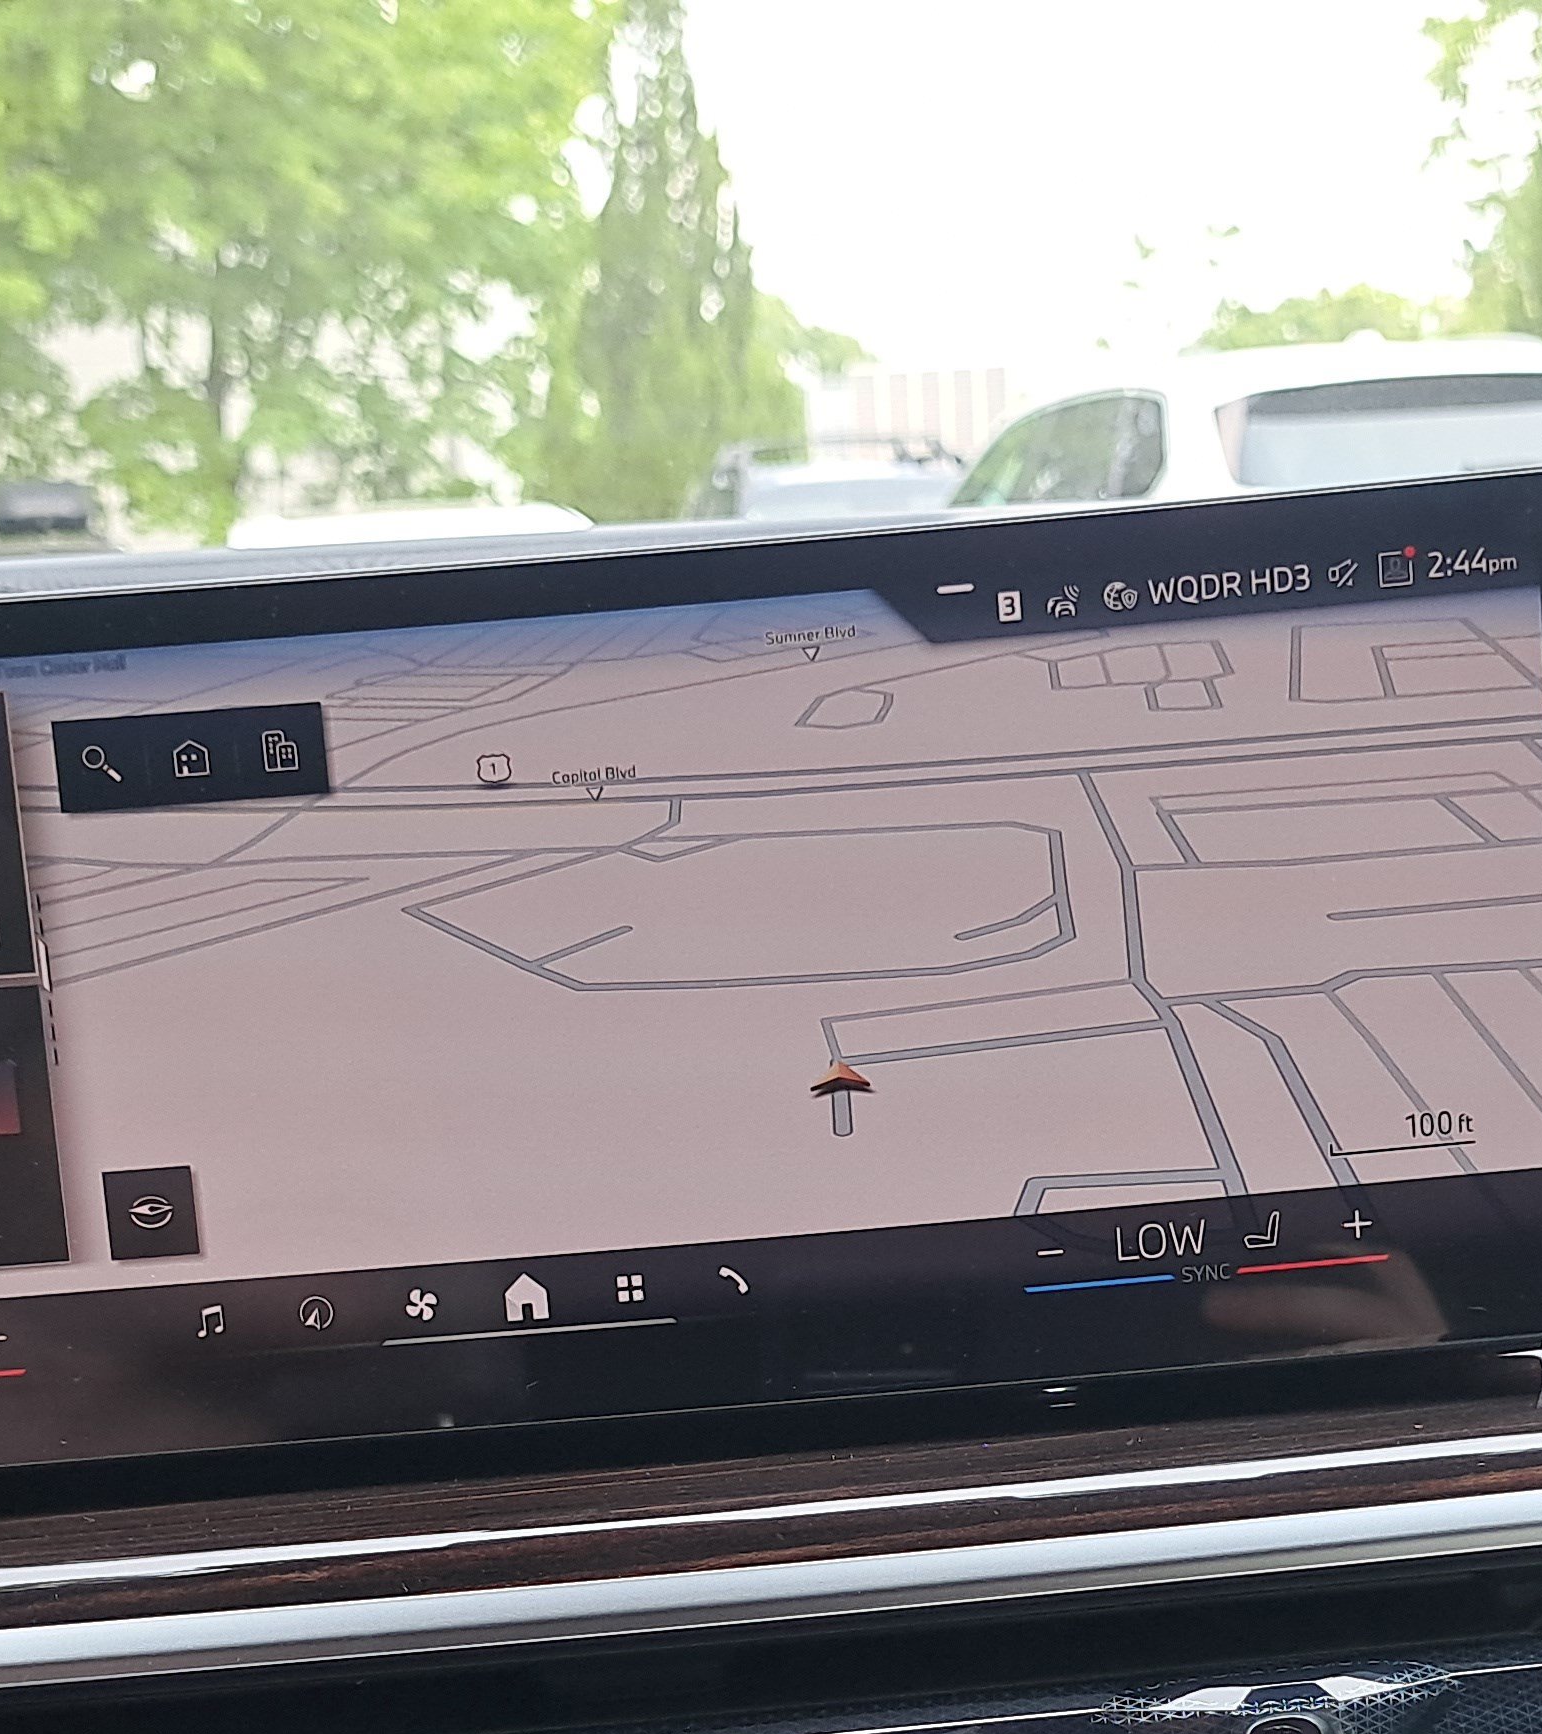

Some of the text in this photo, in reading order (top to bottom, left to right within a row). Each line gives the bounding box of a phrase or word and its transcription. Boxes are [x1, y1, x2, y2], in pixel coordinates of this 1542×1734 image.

[1427, 547, 1519, 580] 2:44pm
[1147, 564, 1312, 606] WQDR HD3
[1002, 594, 1017, 619] 3
[765, 625, 856, 645] Sumner Blvd
[489, 762, 497, 775] 1
[552, 765, 636, 785] Capital Blvd
[1405, 1111, 1474, 1139] 100 ft
[1114, 1218, 1206, 1263] LOW
[1181, 1261, 1231, 1284] SYNC
